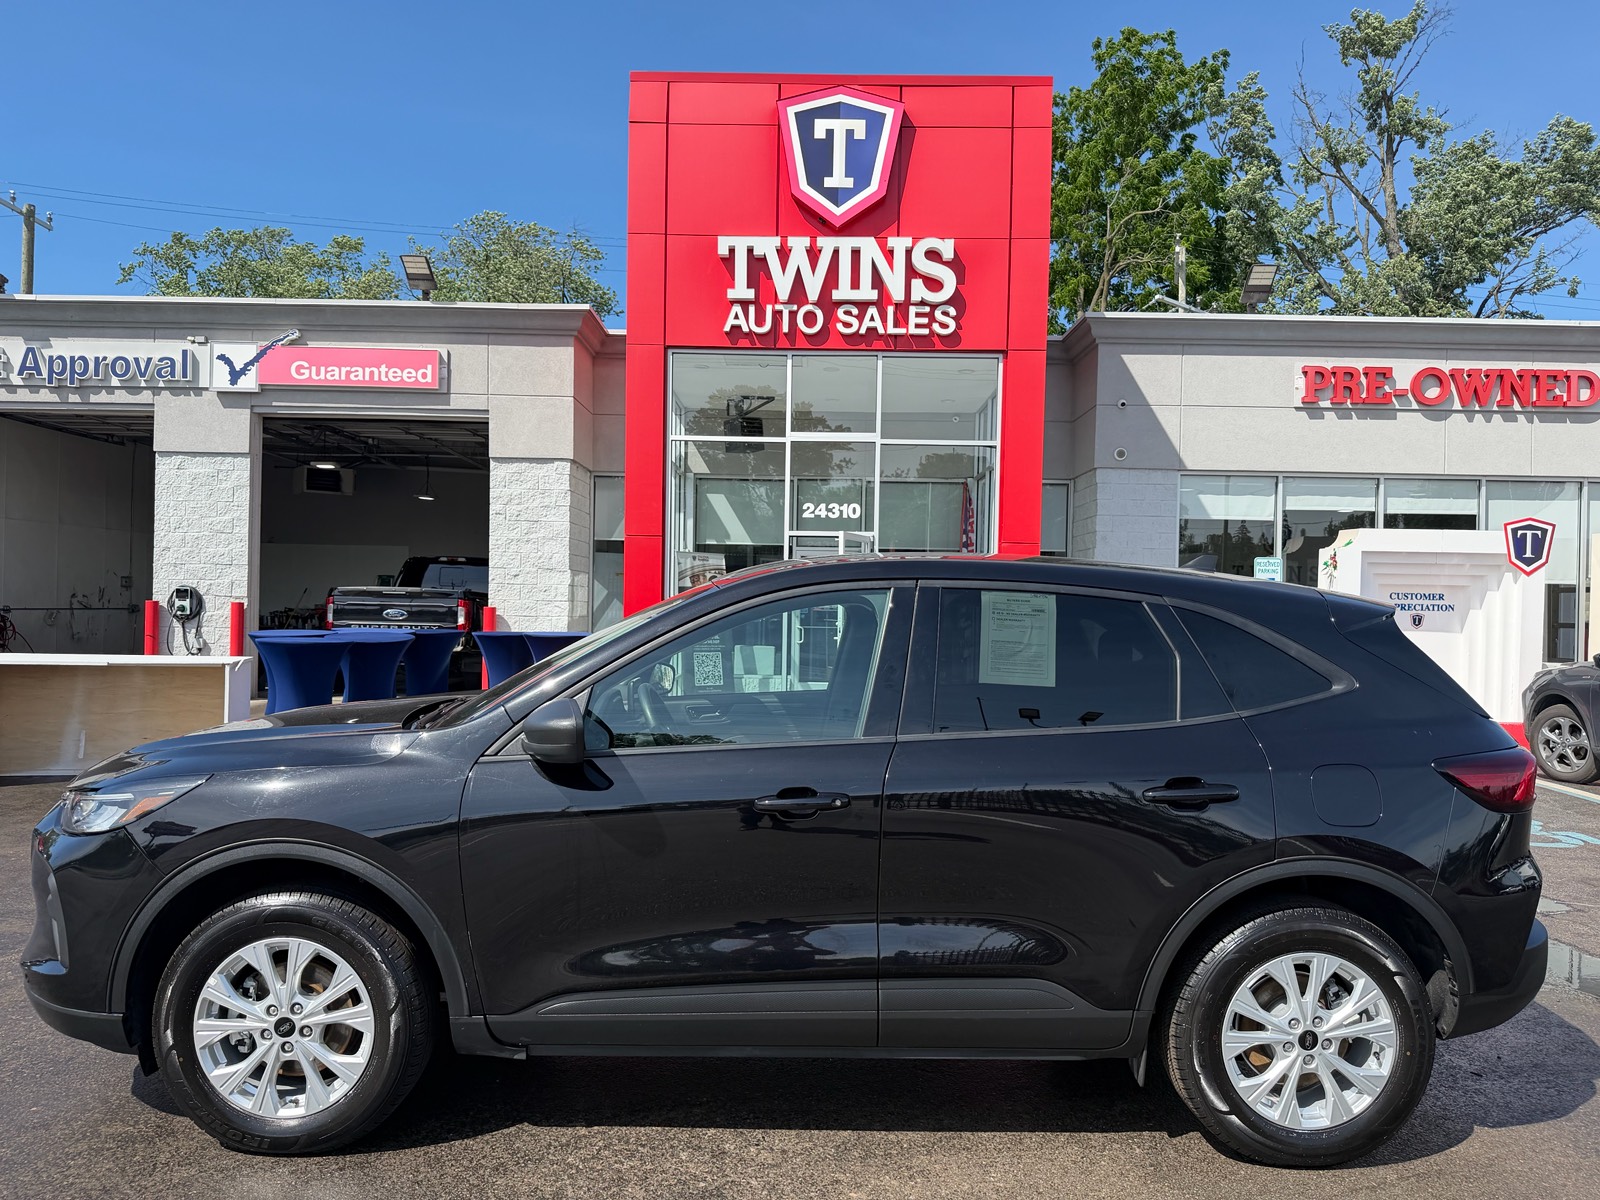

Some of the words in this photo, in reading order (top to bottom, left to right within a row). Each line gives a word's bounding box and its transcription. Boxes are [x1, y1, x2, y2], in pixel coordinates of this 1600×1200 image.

[814, 118, 867, 189] T
[717, 235, 957, 304] TWINS
[723, 303, 824, 335] AUTO
[836, 303, 957, 336] SALES
[17, 346, 193, 388] Approval
[290, 360, 433, 383] Guaranteed
[1301, 365, 1600, 407] PRE-OWNED
[801, 502, 861, 519] 24310
[1517, 530, 1542, 558] T
[1389, 592, 1445, 601] CUSTOMER
[1394, 603, 1455, 612] PRECIATION
